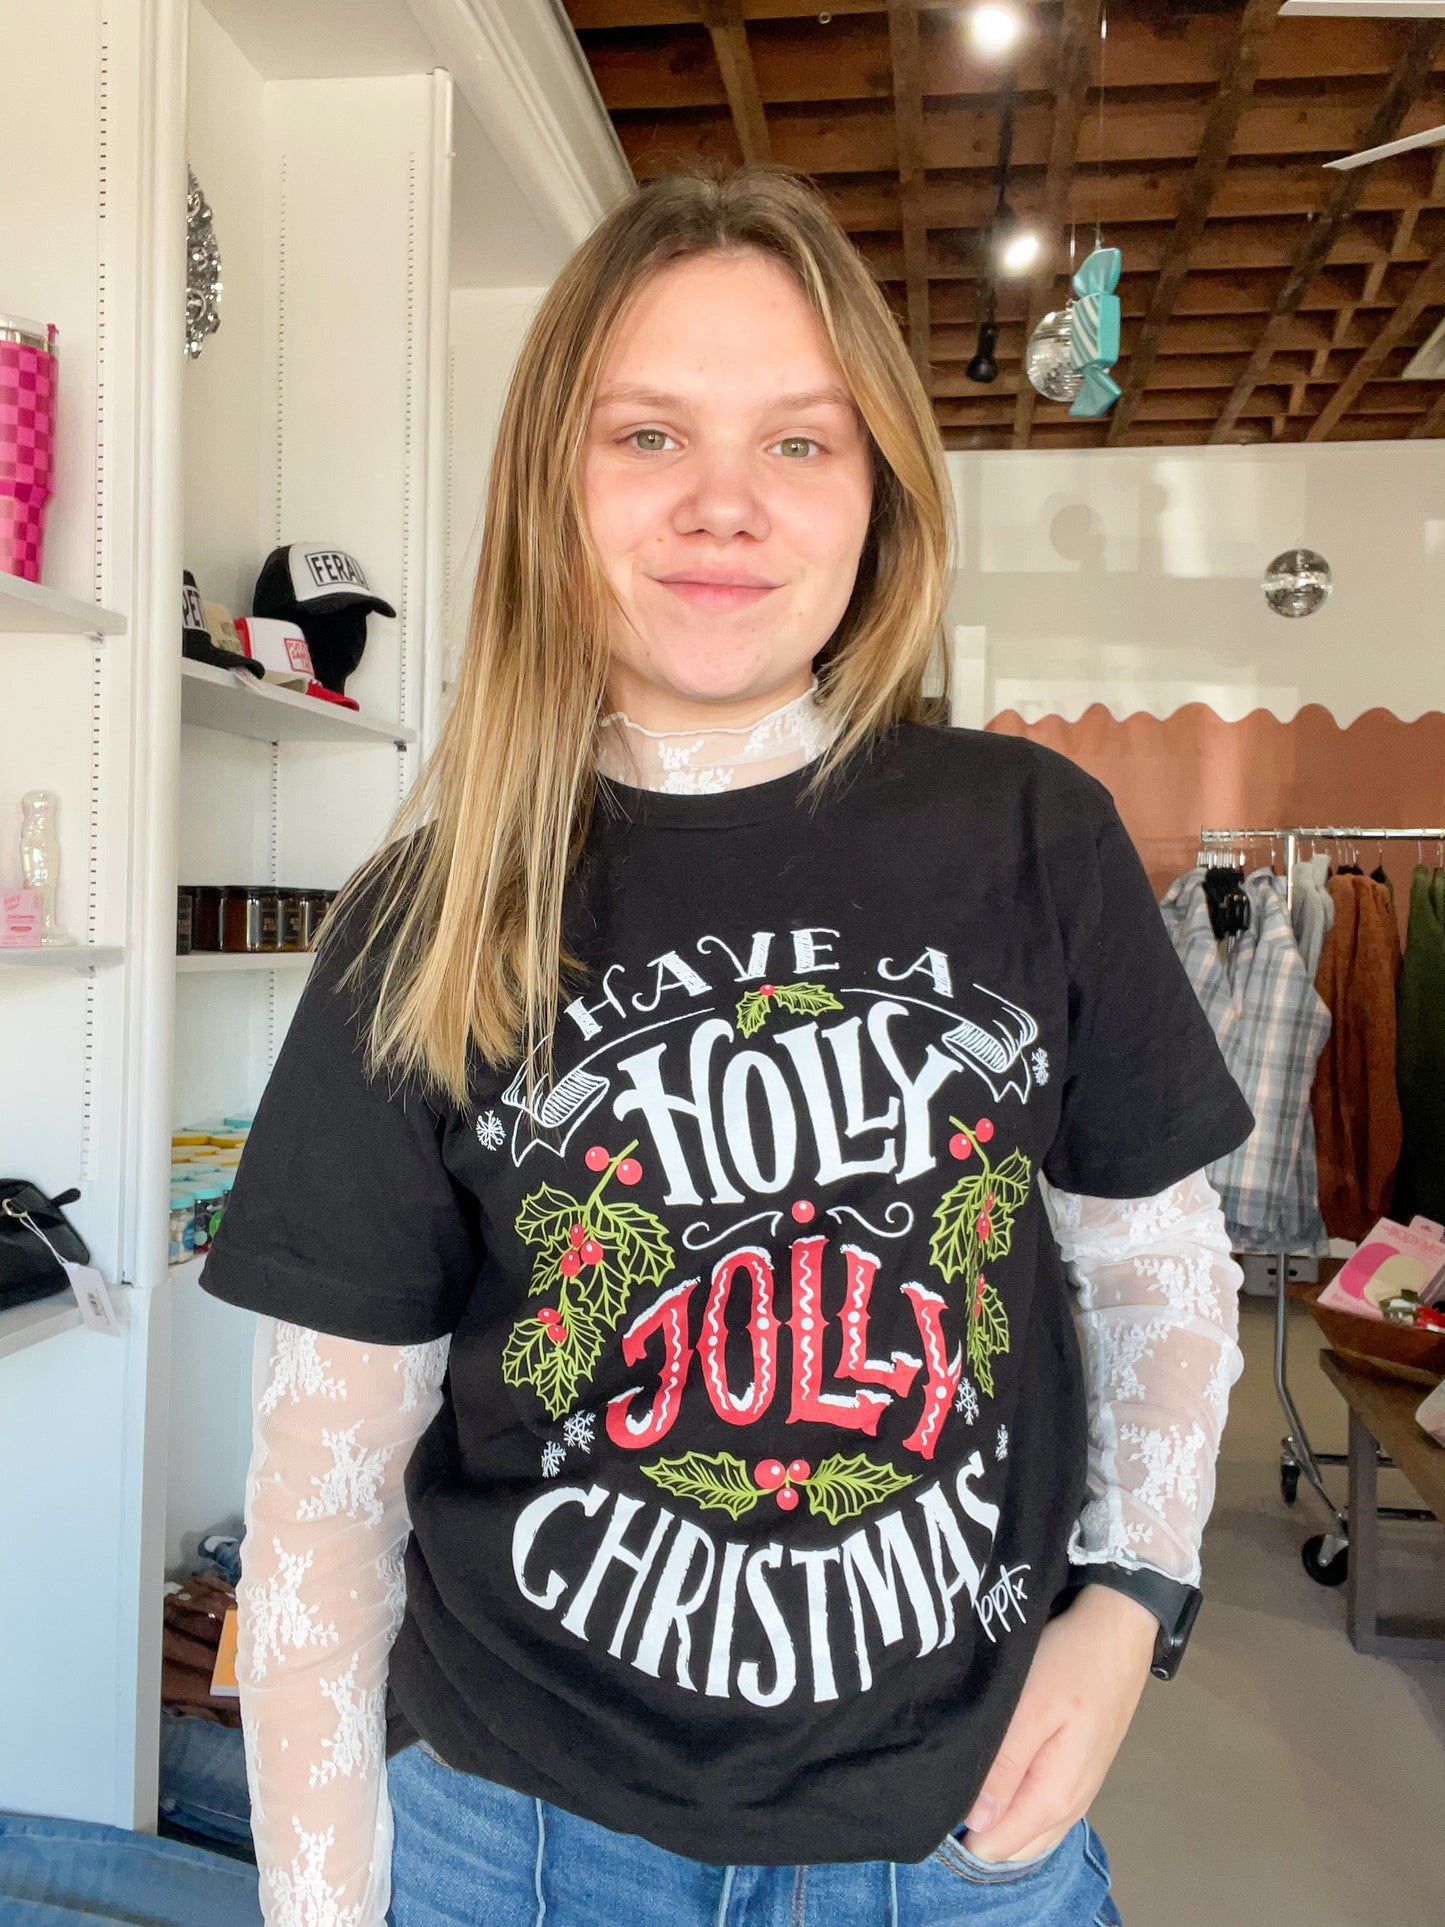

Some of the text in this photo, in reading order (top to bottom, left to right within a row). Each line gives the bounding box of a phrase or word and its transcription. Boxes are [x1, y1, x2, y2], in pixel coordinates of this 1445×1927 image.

[310, 553, 365, 585] FERAL
[564, 928, 954, 1040] HAVE A
[613, 1001, 964, 1206] HOLLY
[605, 1236, 963, 1460] JOLLY
[511, 1450, 1001, 1707] CHRISTMAS
